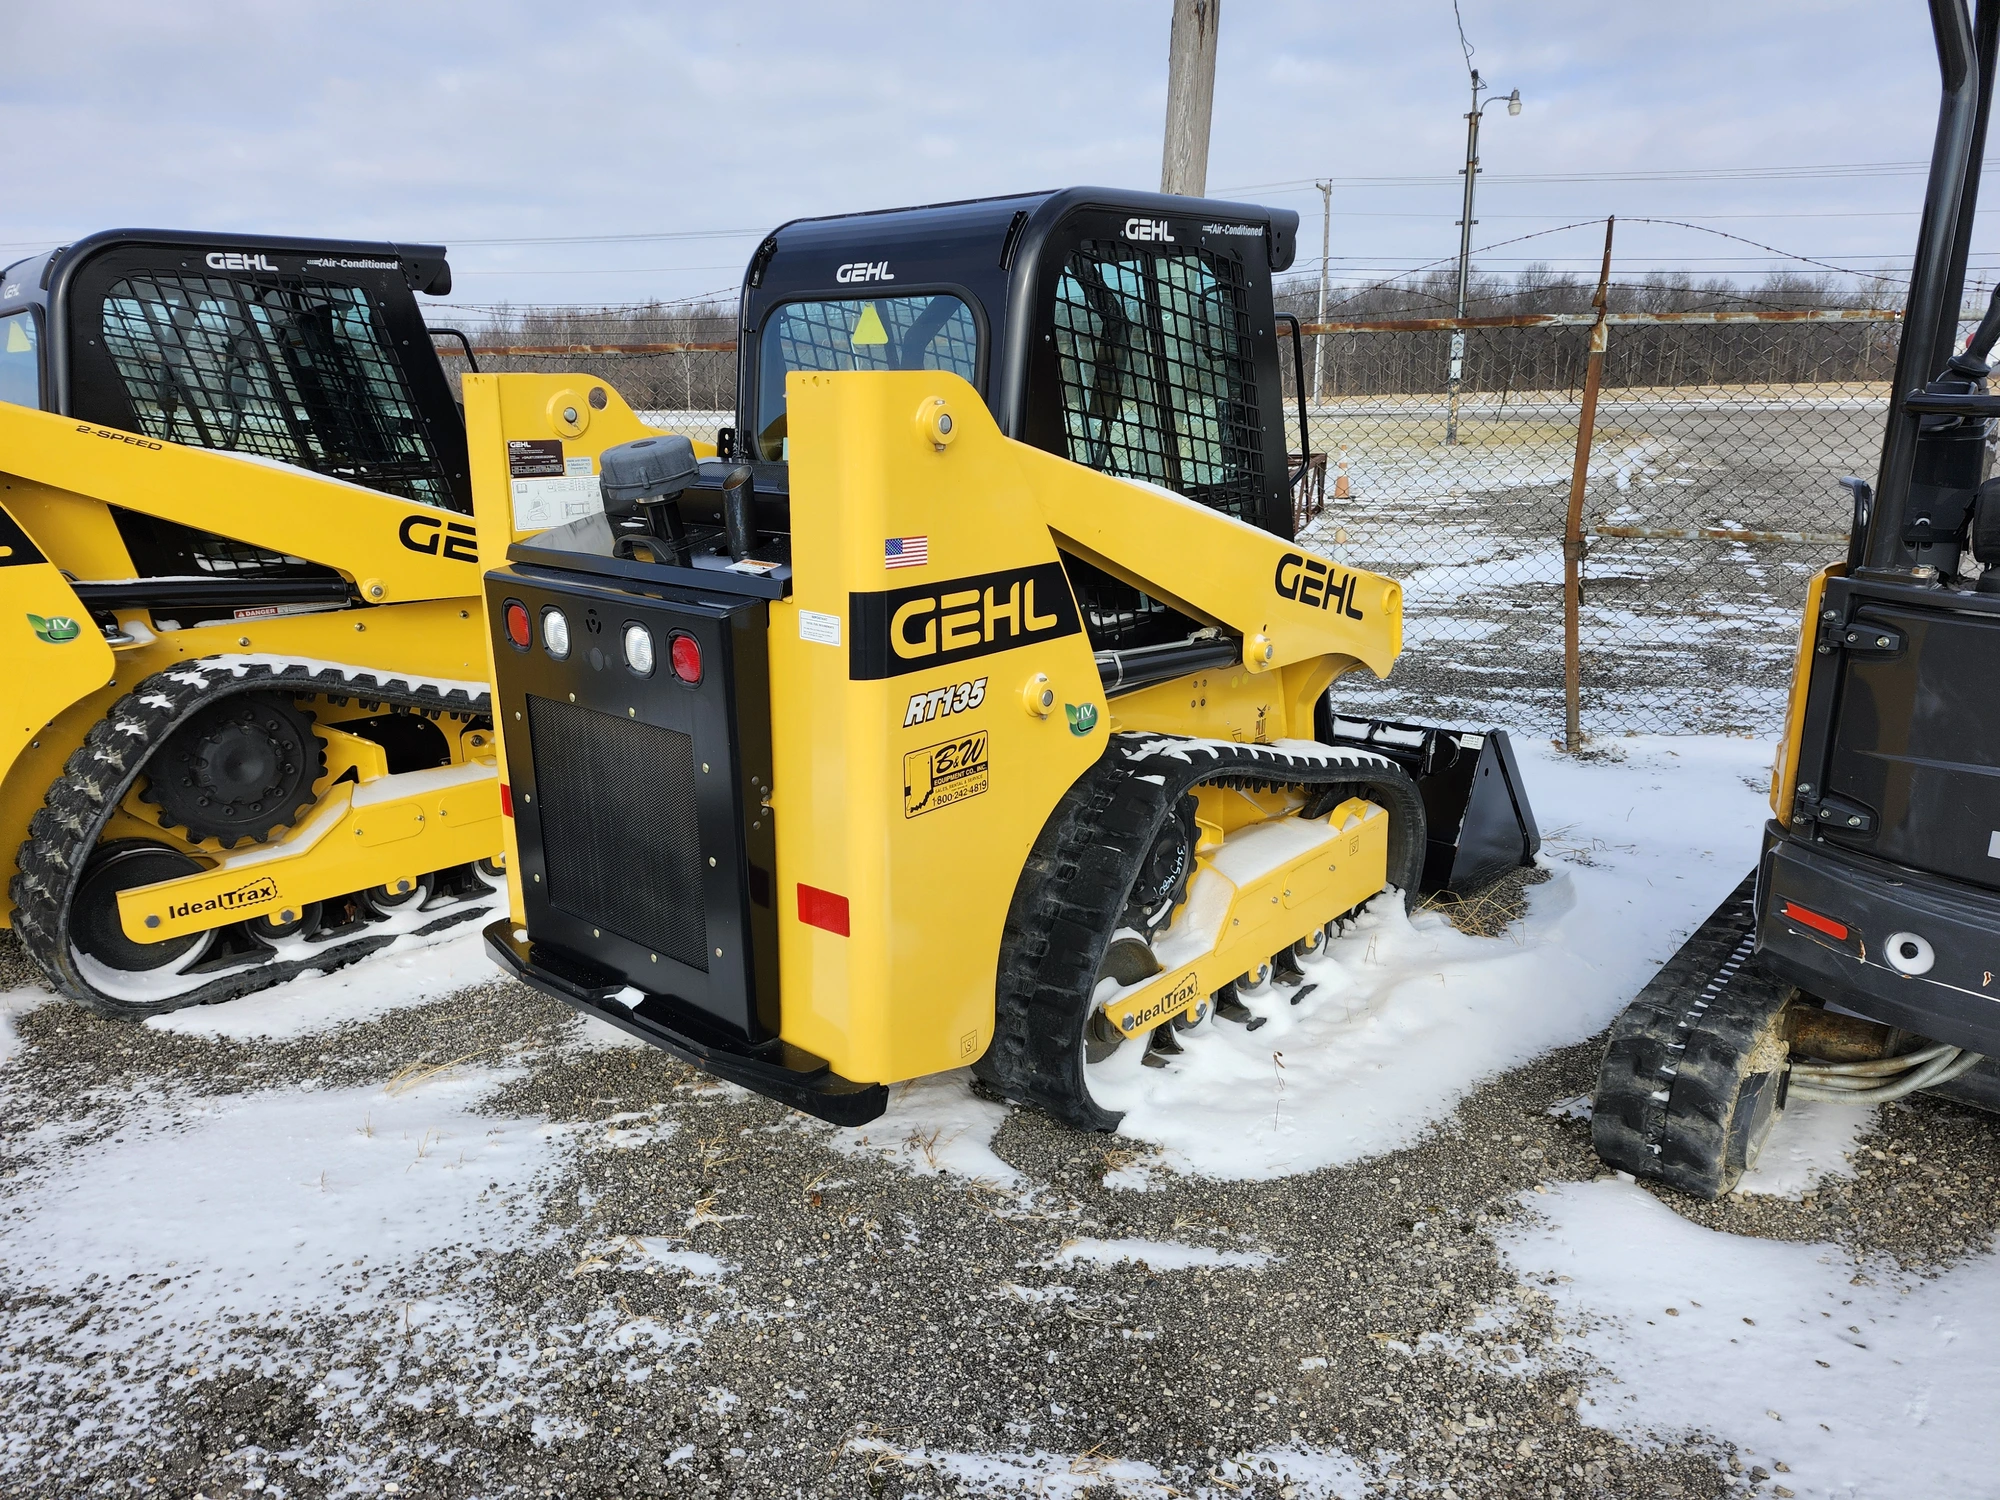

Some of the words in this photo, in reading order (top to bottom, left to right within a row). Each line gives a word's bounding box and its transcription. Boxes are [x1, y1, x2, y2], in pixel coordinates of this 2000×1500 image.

[1125, 218, 1175, 241] GEHL
[1212, 223, 1263, 236] Air-Conditioned
[206, 252, 279, 271] GEHL
[322, 258, 398, 270] Air-Conditioned
[836, 261, 895, 283] GEHL
[76, 425, 162, 451] 2-SPEED
[398, 514, 479, 564] GE
[1274, 553, 1364, 621] GEHL
[245, 608, 276, 617] DANGER
[890, 578, 1058, 660] GEHL
[902, 676, 988, 728] RT135
[934, 737, 985, 774] B&W
[933, 770, 966, 786] EQUIPMENT
[168, 886, 271, 919] IdealTrax
[1134, 983, 1195, 1027] dealTrax
